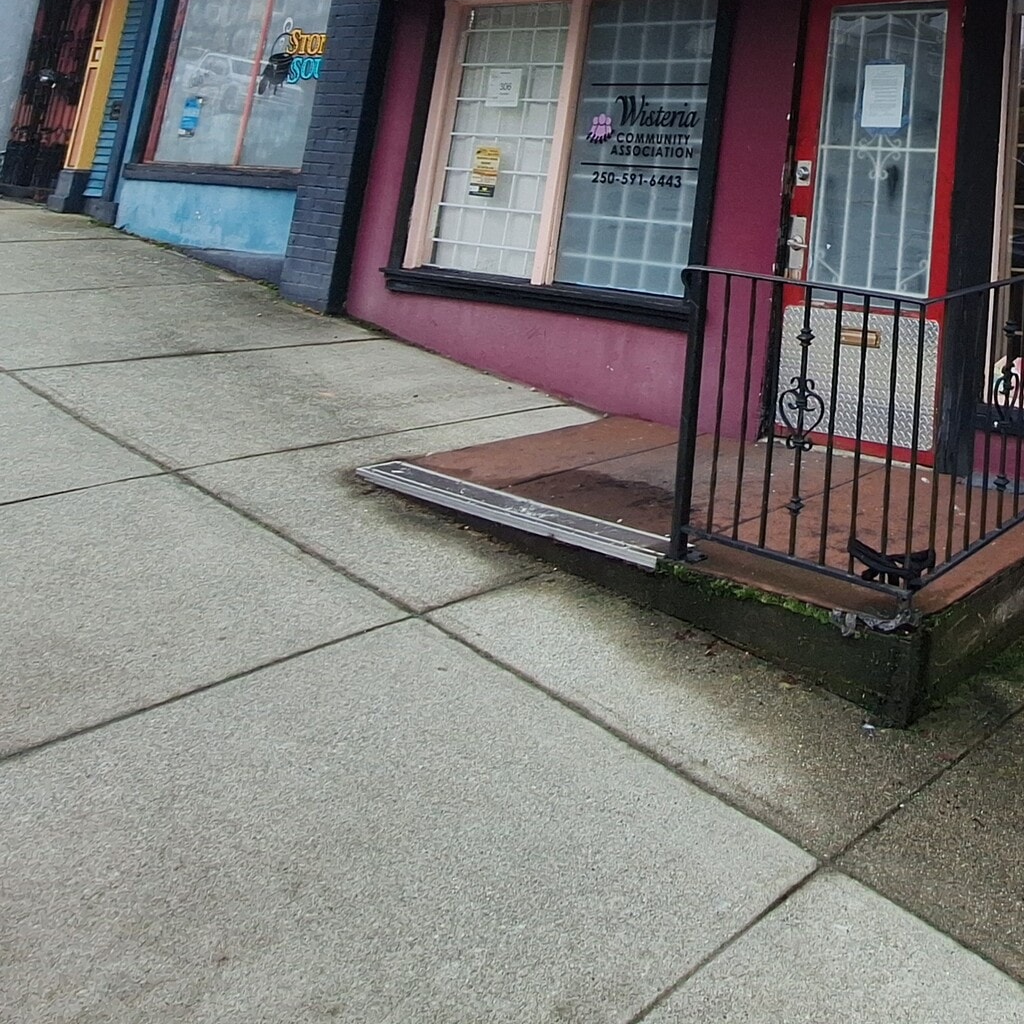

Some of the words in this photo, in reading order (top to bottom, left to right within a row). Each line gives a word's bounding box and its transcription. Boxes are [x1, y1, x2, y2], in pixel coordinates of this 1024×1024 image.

[615, 95, 700, 128] Wisteria
[616, 132, 690, 145] COMMUNITY
[611, 145, 693, 158] ASSOCIATION
[591, 171, 682, 188] 250-591-6443
